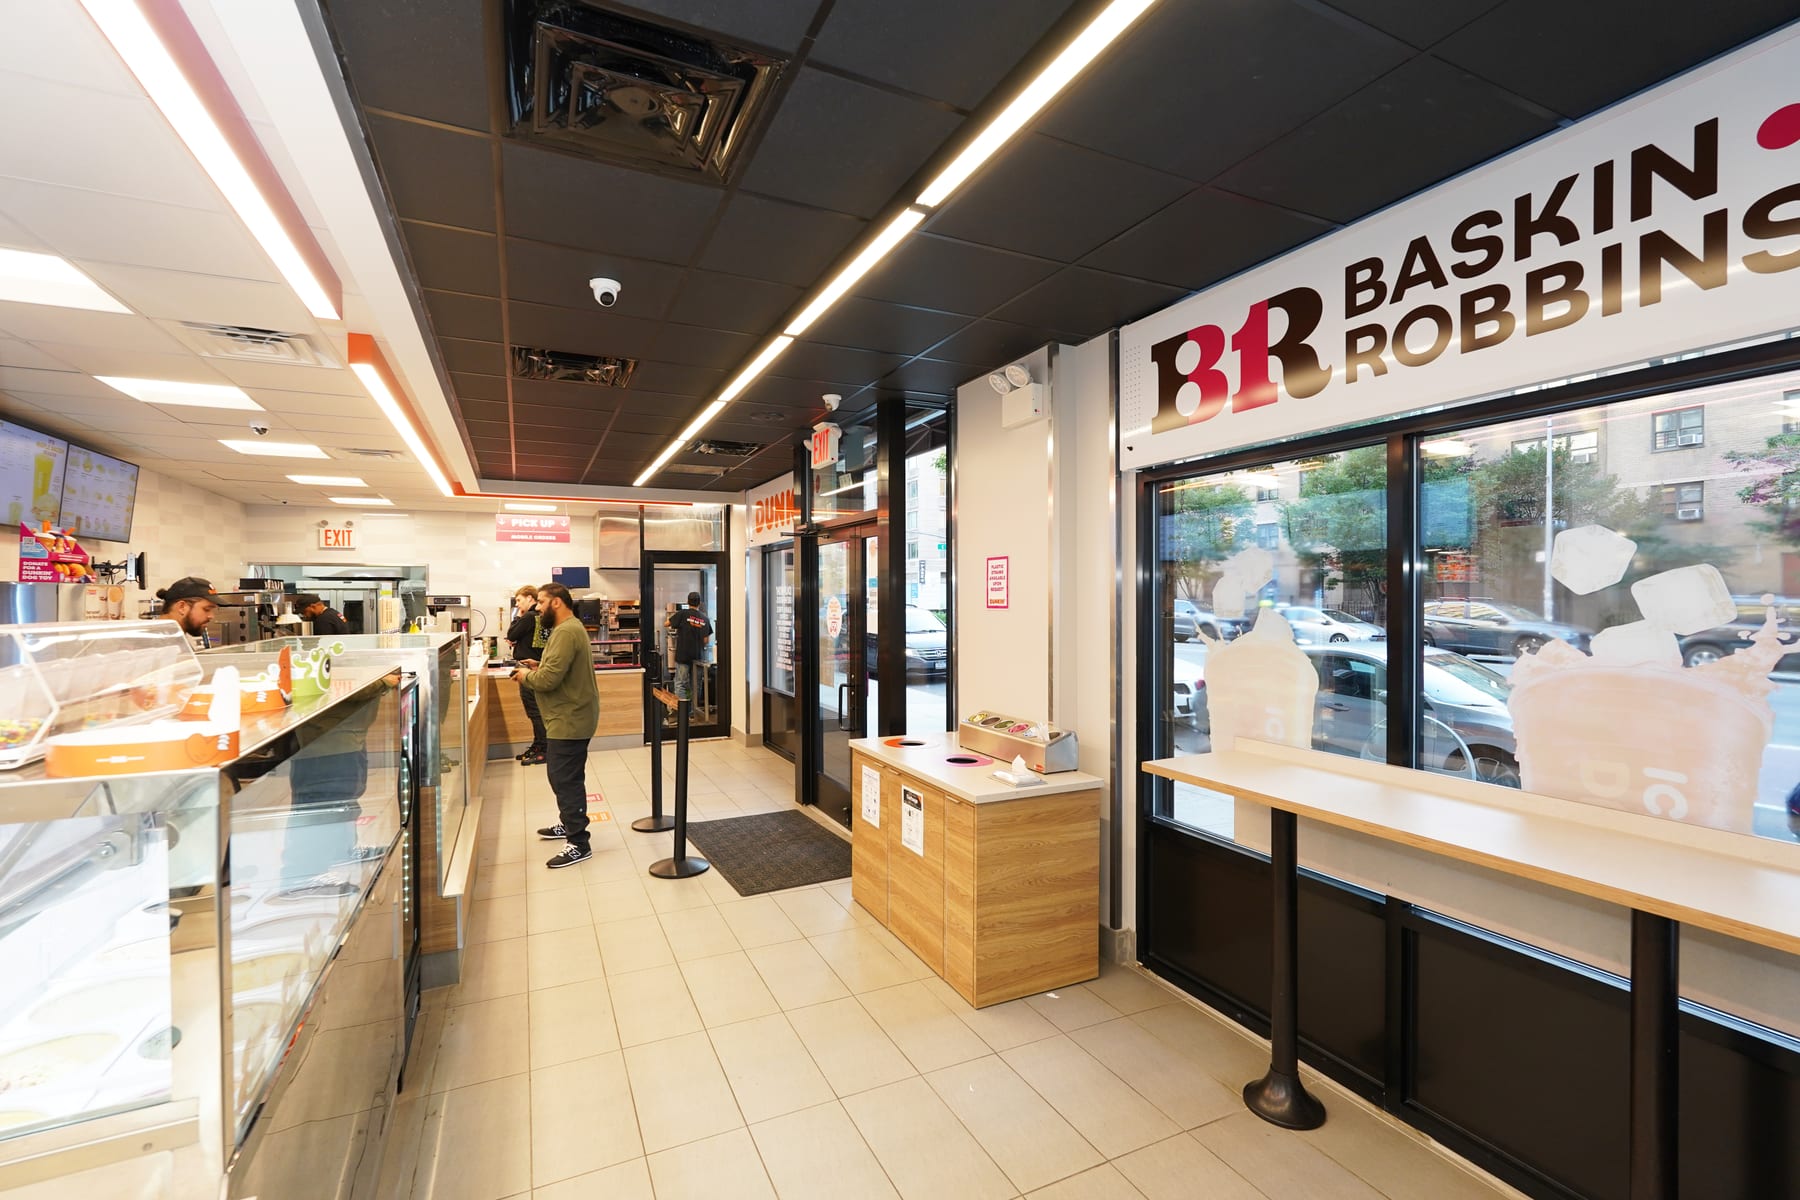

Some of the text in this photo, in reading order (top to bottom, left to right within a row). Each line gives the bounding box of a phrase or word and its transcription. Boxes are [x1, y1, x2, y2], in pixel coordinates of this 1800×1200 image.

[1344, 116, 1719, 320] BASKIN
[1344, 183, 1800, 385] ROBBINS
[1151, 286, 1333, 435] BR
[813, 428, 830, 464] EXIT
[324, 529, 353, 546] EXIT
[511, 518, 555, 528] PICK UP
